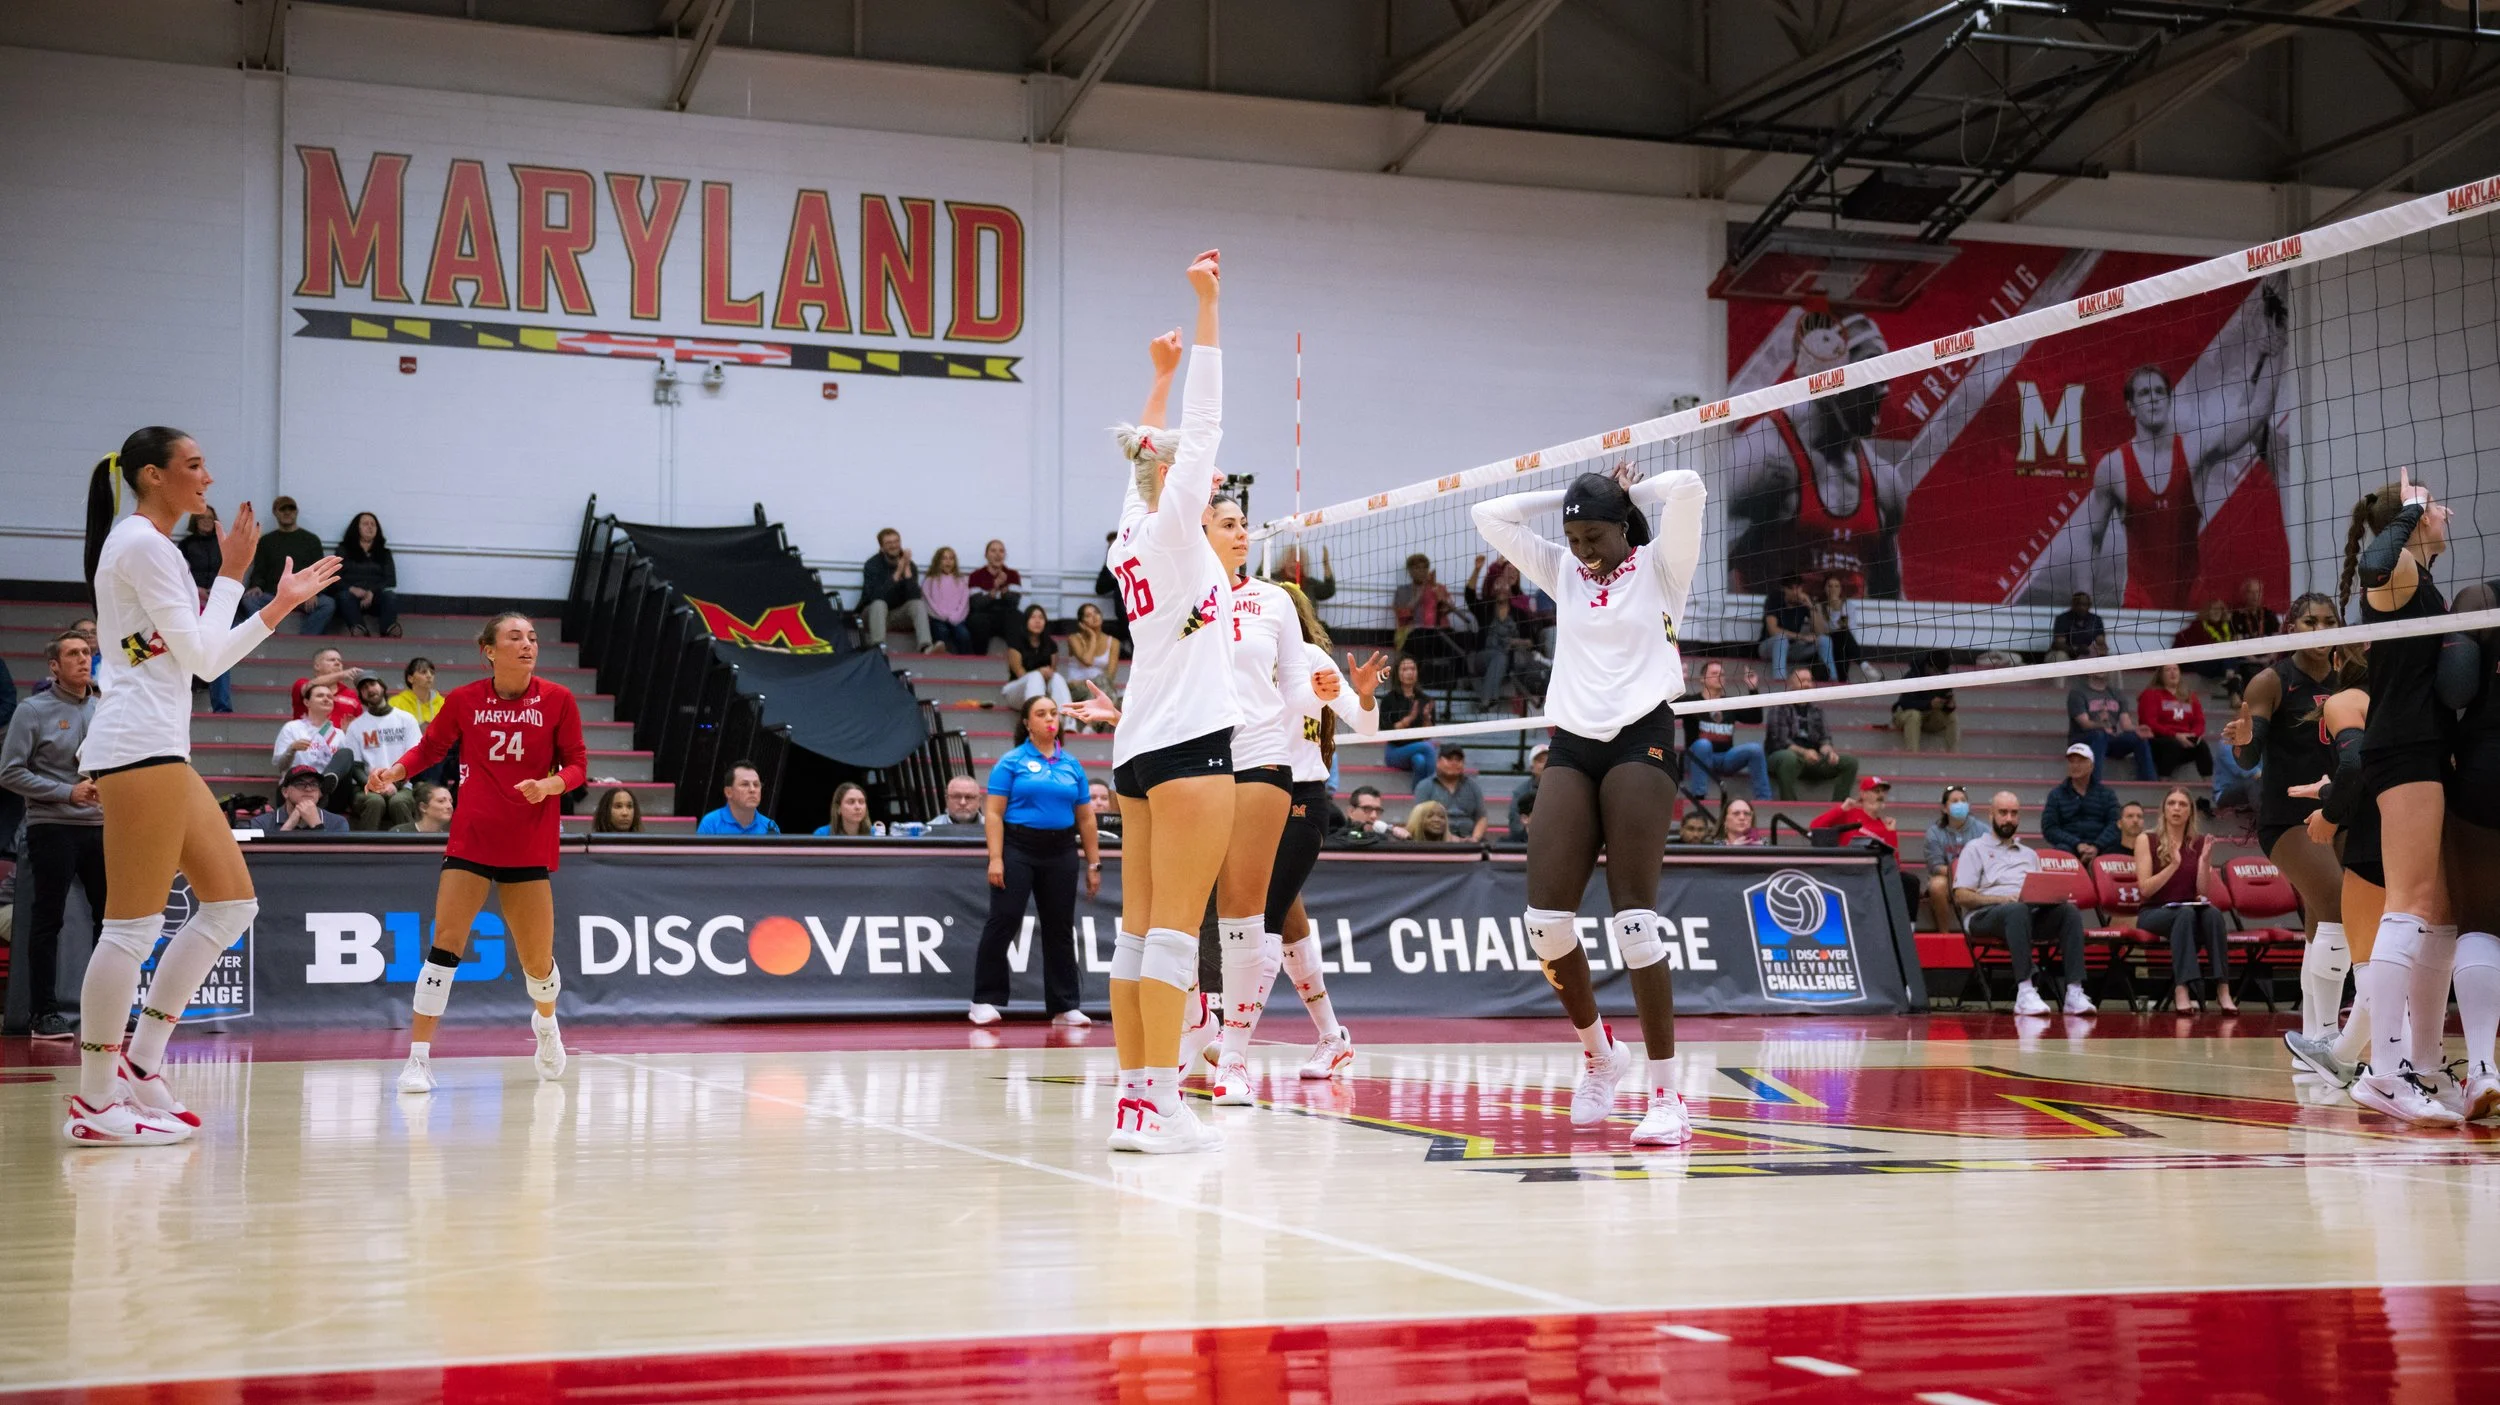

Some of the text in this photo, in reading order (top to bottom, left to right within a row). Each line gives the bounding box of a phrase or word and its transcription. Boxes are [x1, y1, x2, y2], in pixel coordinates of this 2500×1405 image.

[2447, 175, 2500, 212] MARYLAN
[293, 144, 1025, 343] MARYLAND
[2247, 235, 2302, 268] MARYLAND
[2077, 286, 2125, 316] MARYLAND
[1933, 330, 1975, 357] MARYLAND
[1808, 367, 1845, 390] MARYLAND
[2016, 380, 2088, 465] M
[1998, 489, 2080, 592] MARYLAND
[1115, 556, 1155, 622] 26
[473, 708, 543, 727] MARYLAND
[362, 729, 380, 750] M
[489, 730, 525, 762] 24
[2040, 857, 2079, 869] ARYLAND
[2233, 864, 2280, 877] MARYLAND
[1764, 962, 1853, 974] VOLLEYBALL
[1796, 949, 1849, 961] DISCOVER
[1766, 974, 1857, 990] CHALLENGE
